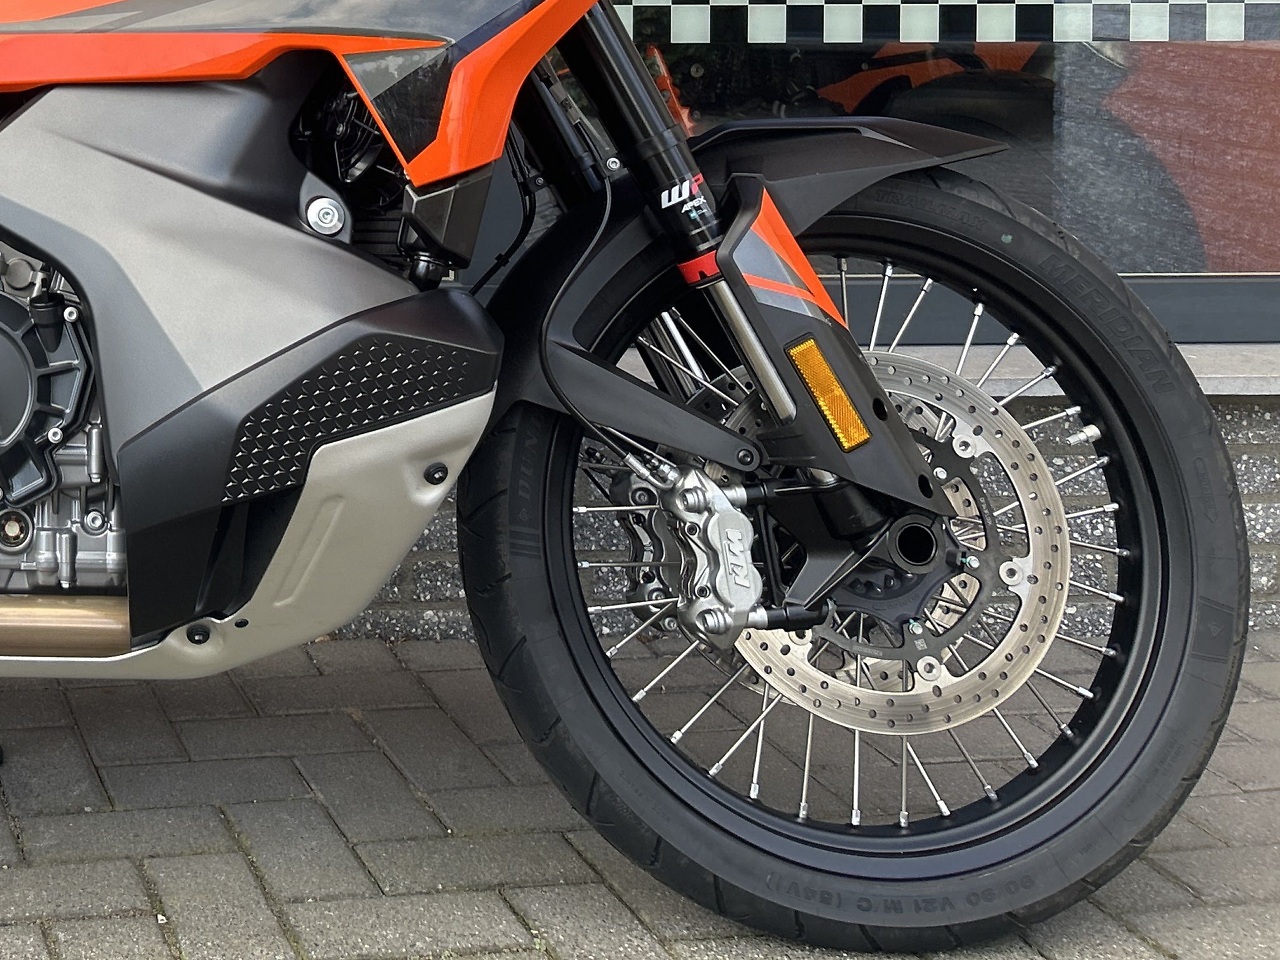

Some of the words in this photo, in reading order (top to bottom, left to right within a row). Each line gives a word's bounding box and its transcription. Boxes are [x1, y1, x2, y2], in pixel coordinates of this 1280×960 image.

[661, 173, 704, 209] WP
[681, 196, 707, 213] APEX
[875, 190, 989, 231] TRAILMAX
[1040, 254, 1176, 394] MERIDIAN
[723, 528, 751, 589] KTM
